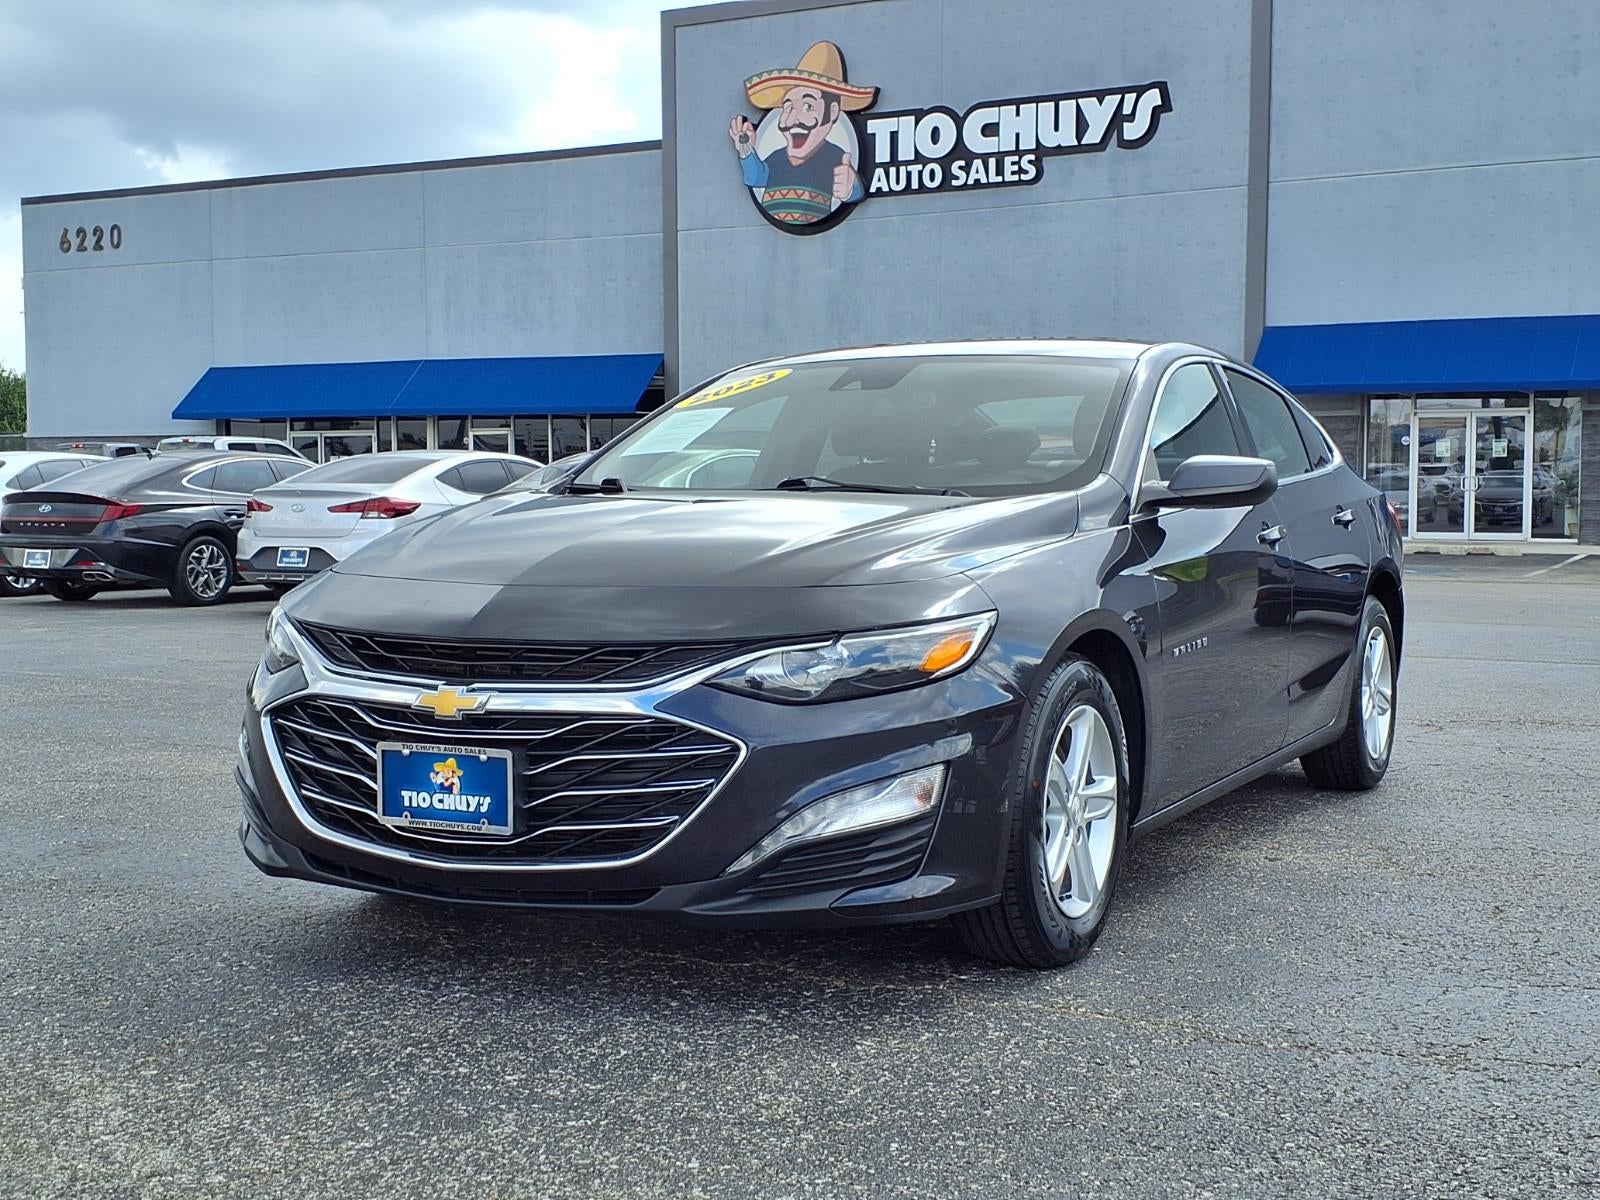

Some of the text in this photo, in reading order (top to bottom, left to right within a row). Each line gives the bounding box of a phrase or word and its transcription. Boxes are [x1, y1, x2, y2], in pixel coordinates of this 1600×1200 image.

[867, 88, 1162, 163] TIO CHUY'S
[870, 155, 1037, 192] AUTO SALES
[59, 223, 122, 253] 6220
[401, 743, 414, 751] TIO
[443, 746, 463, 754] AUTO
[464, 747, 488, 756] SALES
[401, 790, 491, 813] TIO CHUY'S
